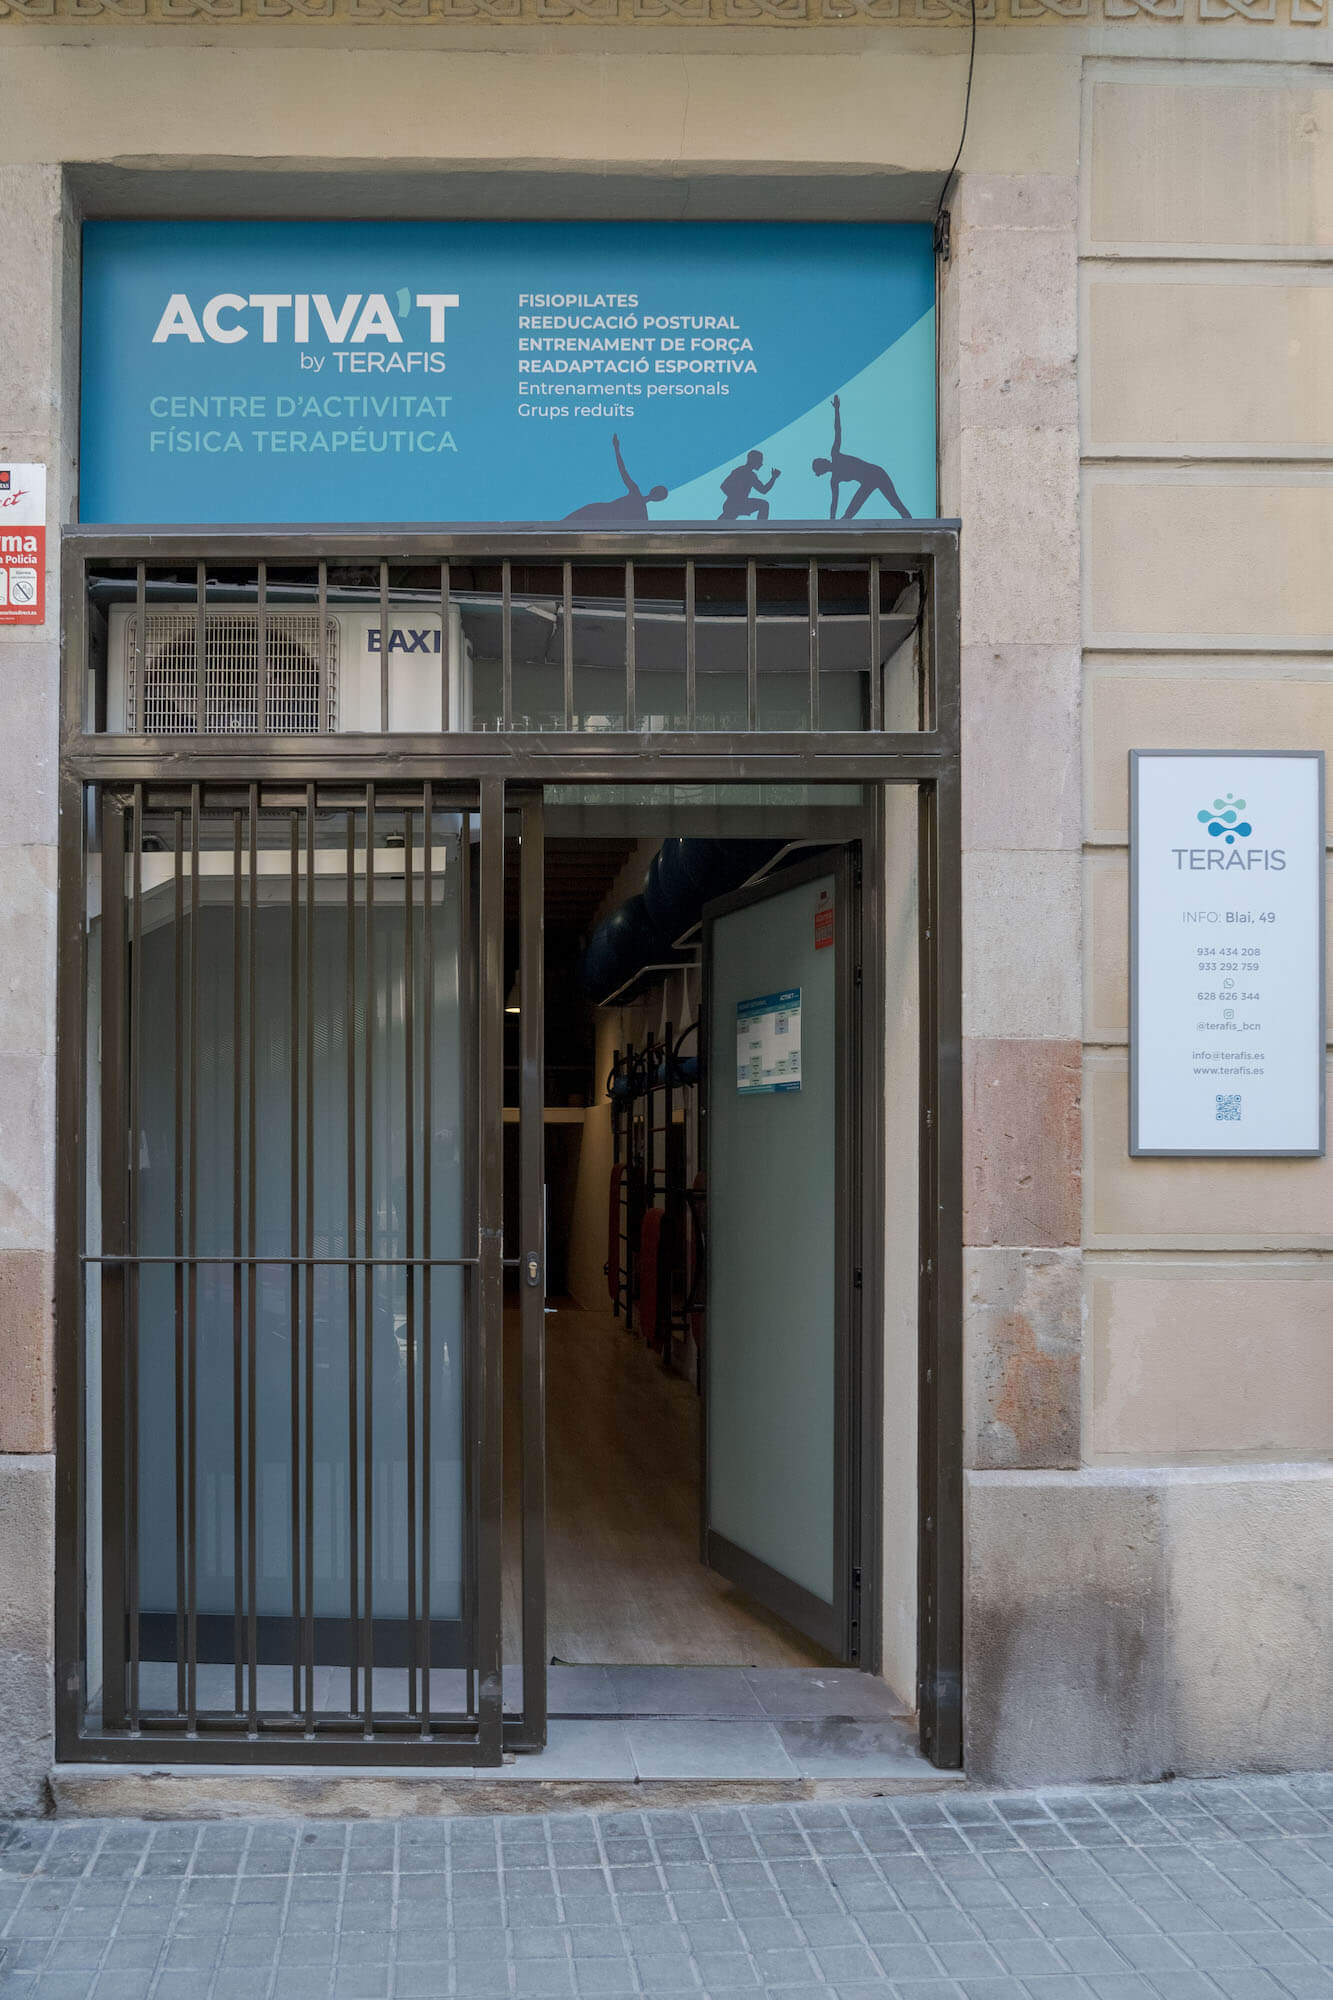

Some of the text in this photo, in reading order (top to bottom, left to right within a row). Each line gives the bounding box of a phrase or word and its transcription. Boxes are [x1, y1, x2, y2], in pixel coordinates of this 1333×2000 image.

[519, 294, 639, 307] FISIOPILATES
[152, 287, 459, 343] ACTIVA'T
[519, 314, 740, 329] REEDUCACIÓ POSTURAL
[519, 338, 753, 354] ENTRENAMENT DE FORÇA
[301, 351, 446, 373] by TERAFIS
[519, 357, 757, 373] READAPTACIÓ ESPORTIVA
[519, 381, 729, 398] Entrenaments personals
[150, 396, 452, 418] CENTRE D'ACTIVITAT
[518, 403, 634, 420] Grups reduïts
[151, 426, 458, 452] FÍSICA TERAPÉUTICA
[0, 535, 37, 552] ma
[368, 629, 441, 653] BAXI
[1172, 849, 1286, 871] TERAFIS
[1182, 912, 1276, 924] INFO: Blai, 49
[1197, 948, 1260, 956] 934 434 208
[1199, 963, 1259, 971] 933 292 759
[1197, 992, 1260, 1001] 628 626 344
[1196, 1022, 1261, 1032] @terafis_bcn
[1192, 1051, 1265, 1060] info@terafis.es
[1194, 1066, 1264, 1075] www.terafis.es
